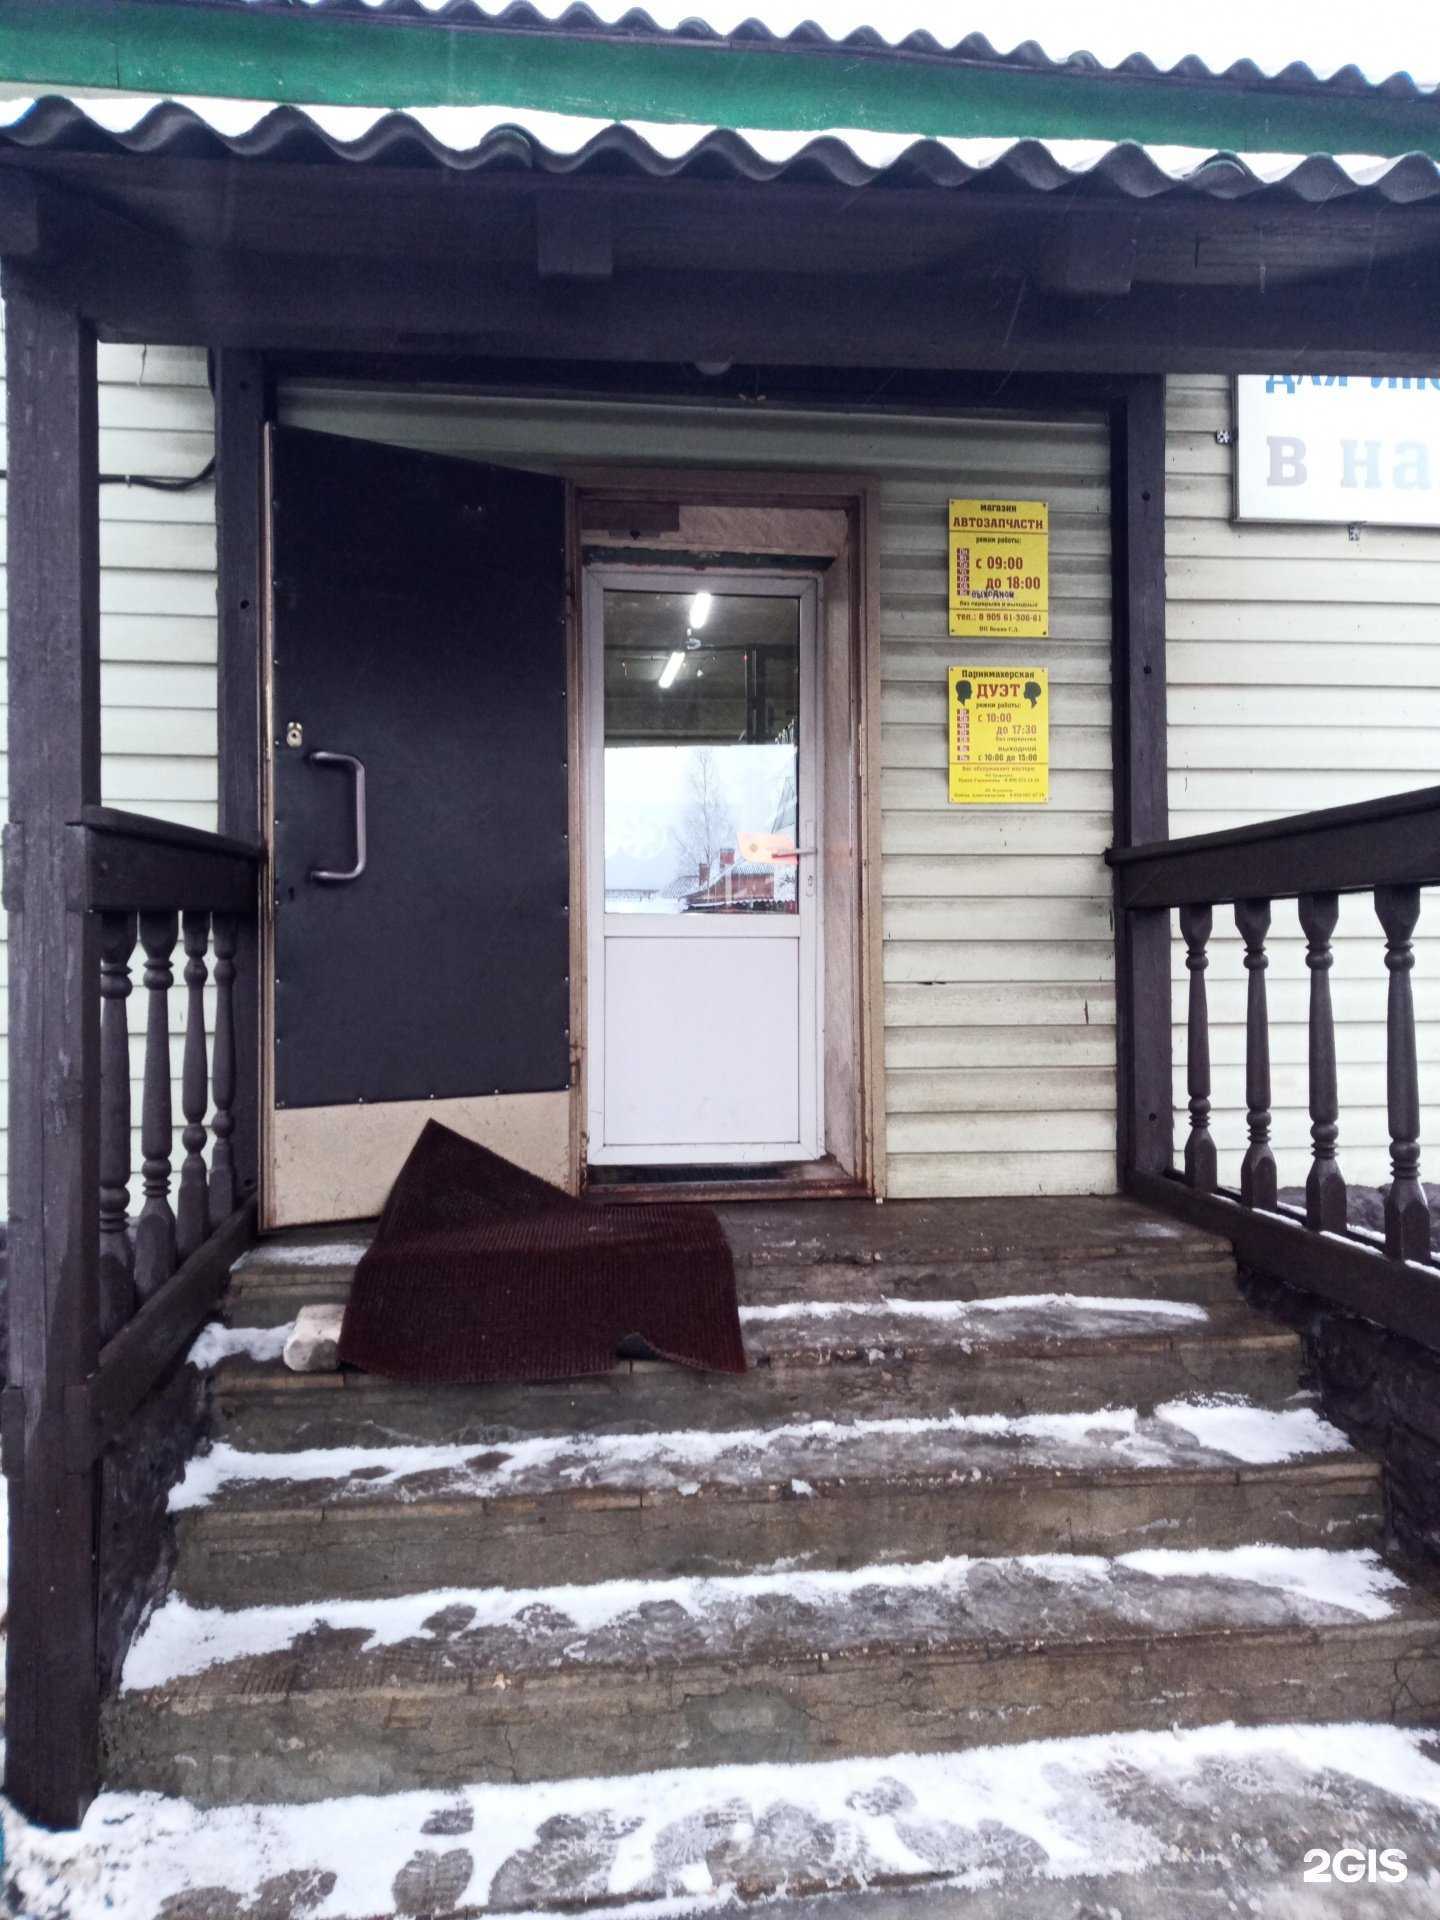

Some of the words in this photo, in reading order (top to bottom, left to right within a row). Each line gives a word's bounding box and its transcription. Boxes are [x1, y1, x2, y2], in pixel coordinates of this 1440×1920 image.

[1340, 439, 1440, 490] на
[980, 503, 1017, 513] магазин
[953, 516, 1043, 529] АВТОЗАПЧАСТИ
[986, 556, 1024, 570] 09:00
[985, 578, 1002, 591] до
[1007, 576, 1041, 590] 18:00
[962, 669, 1035, 680] Парикмахерская
[976, 683, 1021, 699] ДУЭТ
[986, 712, 1012, 723] 10:00
[1012, 724, 1037, 735] 17:30
